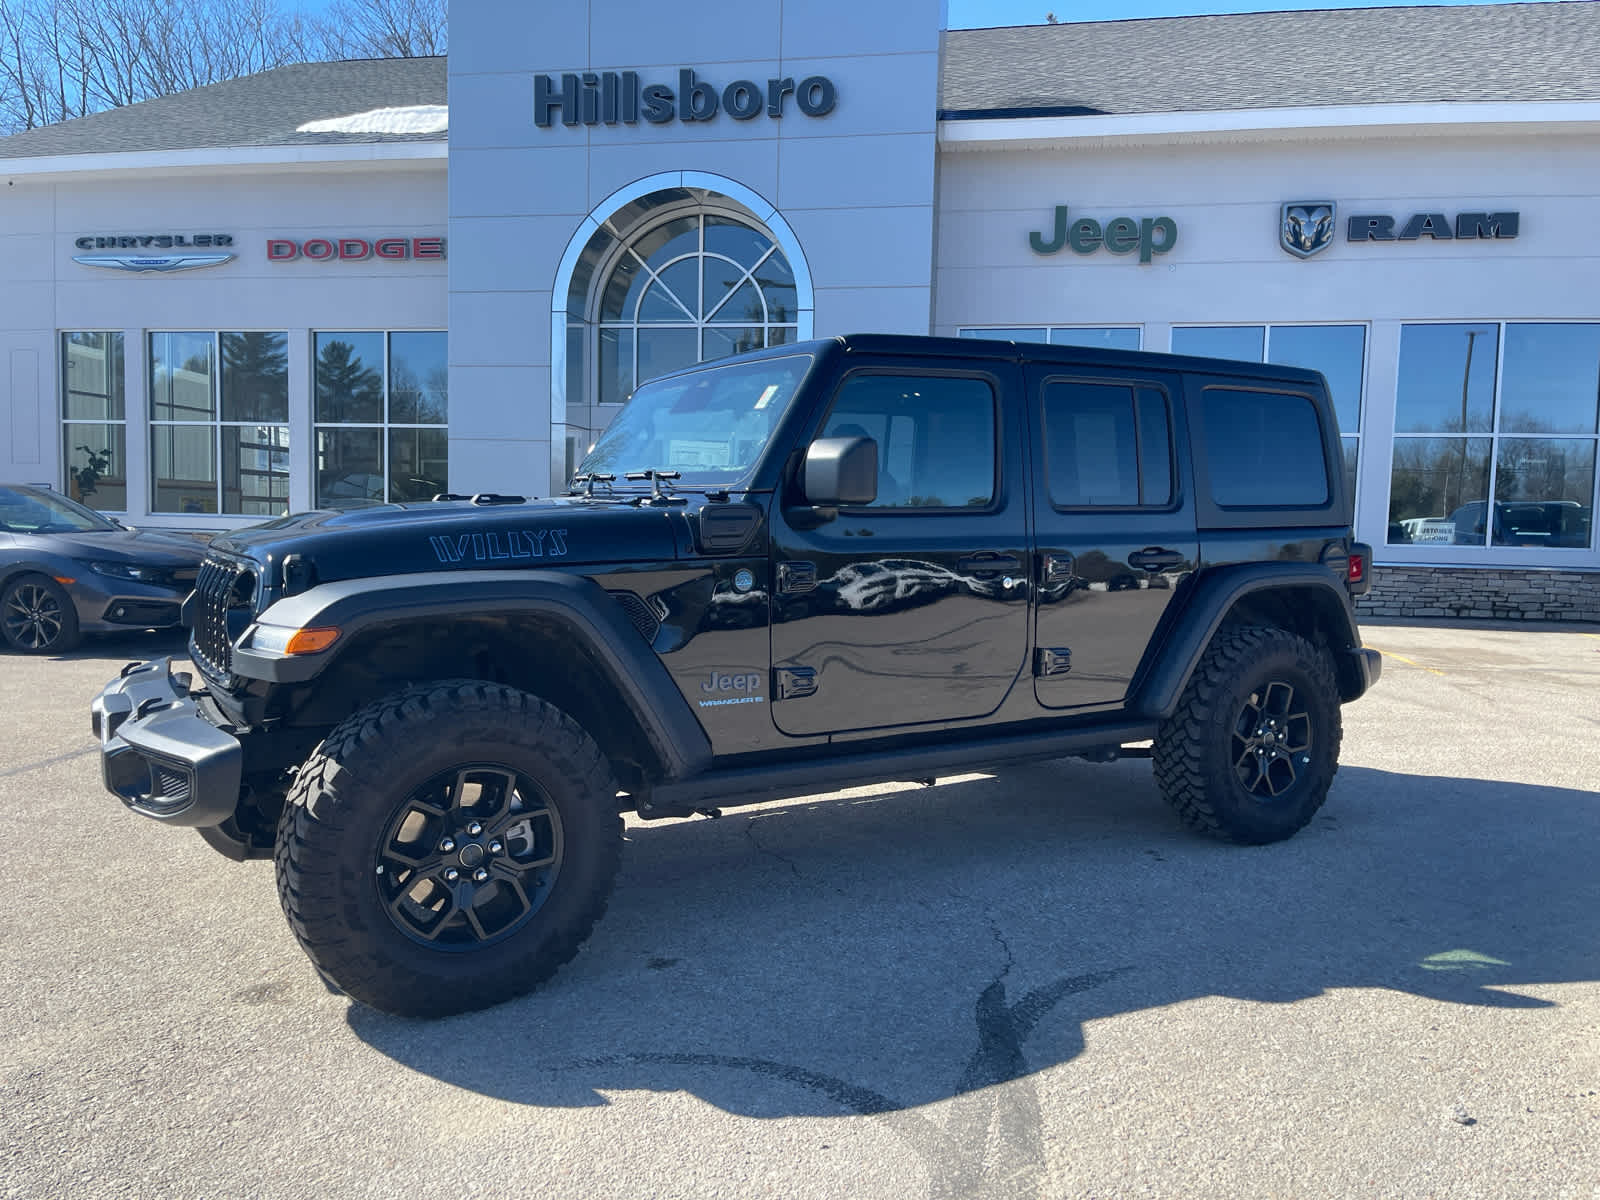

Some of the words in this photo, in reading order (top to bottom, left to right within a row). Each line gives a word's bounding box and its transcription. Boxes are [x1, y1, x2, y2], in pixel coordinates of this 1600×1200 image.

[533, 68, 837, 128] Hillsboro
[75, 234, 233, 250] CHRYSLER
[1029, 205, 1177, 265] Jeep
[1347, 211, 1519, 242] RAM
[267, 238, 447, 261] DODGE
[429, 528, 568, 562] WILLYS
[701, 671, 760, 696] Jeep
